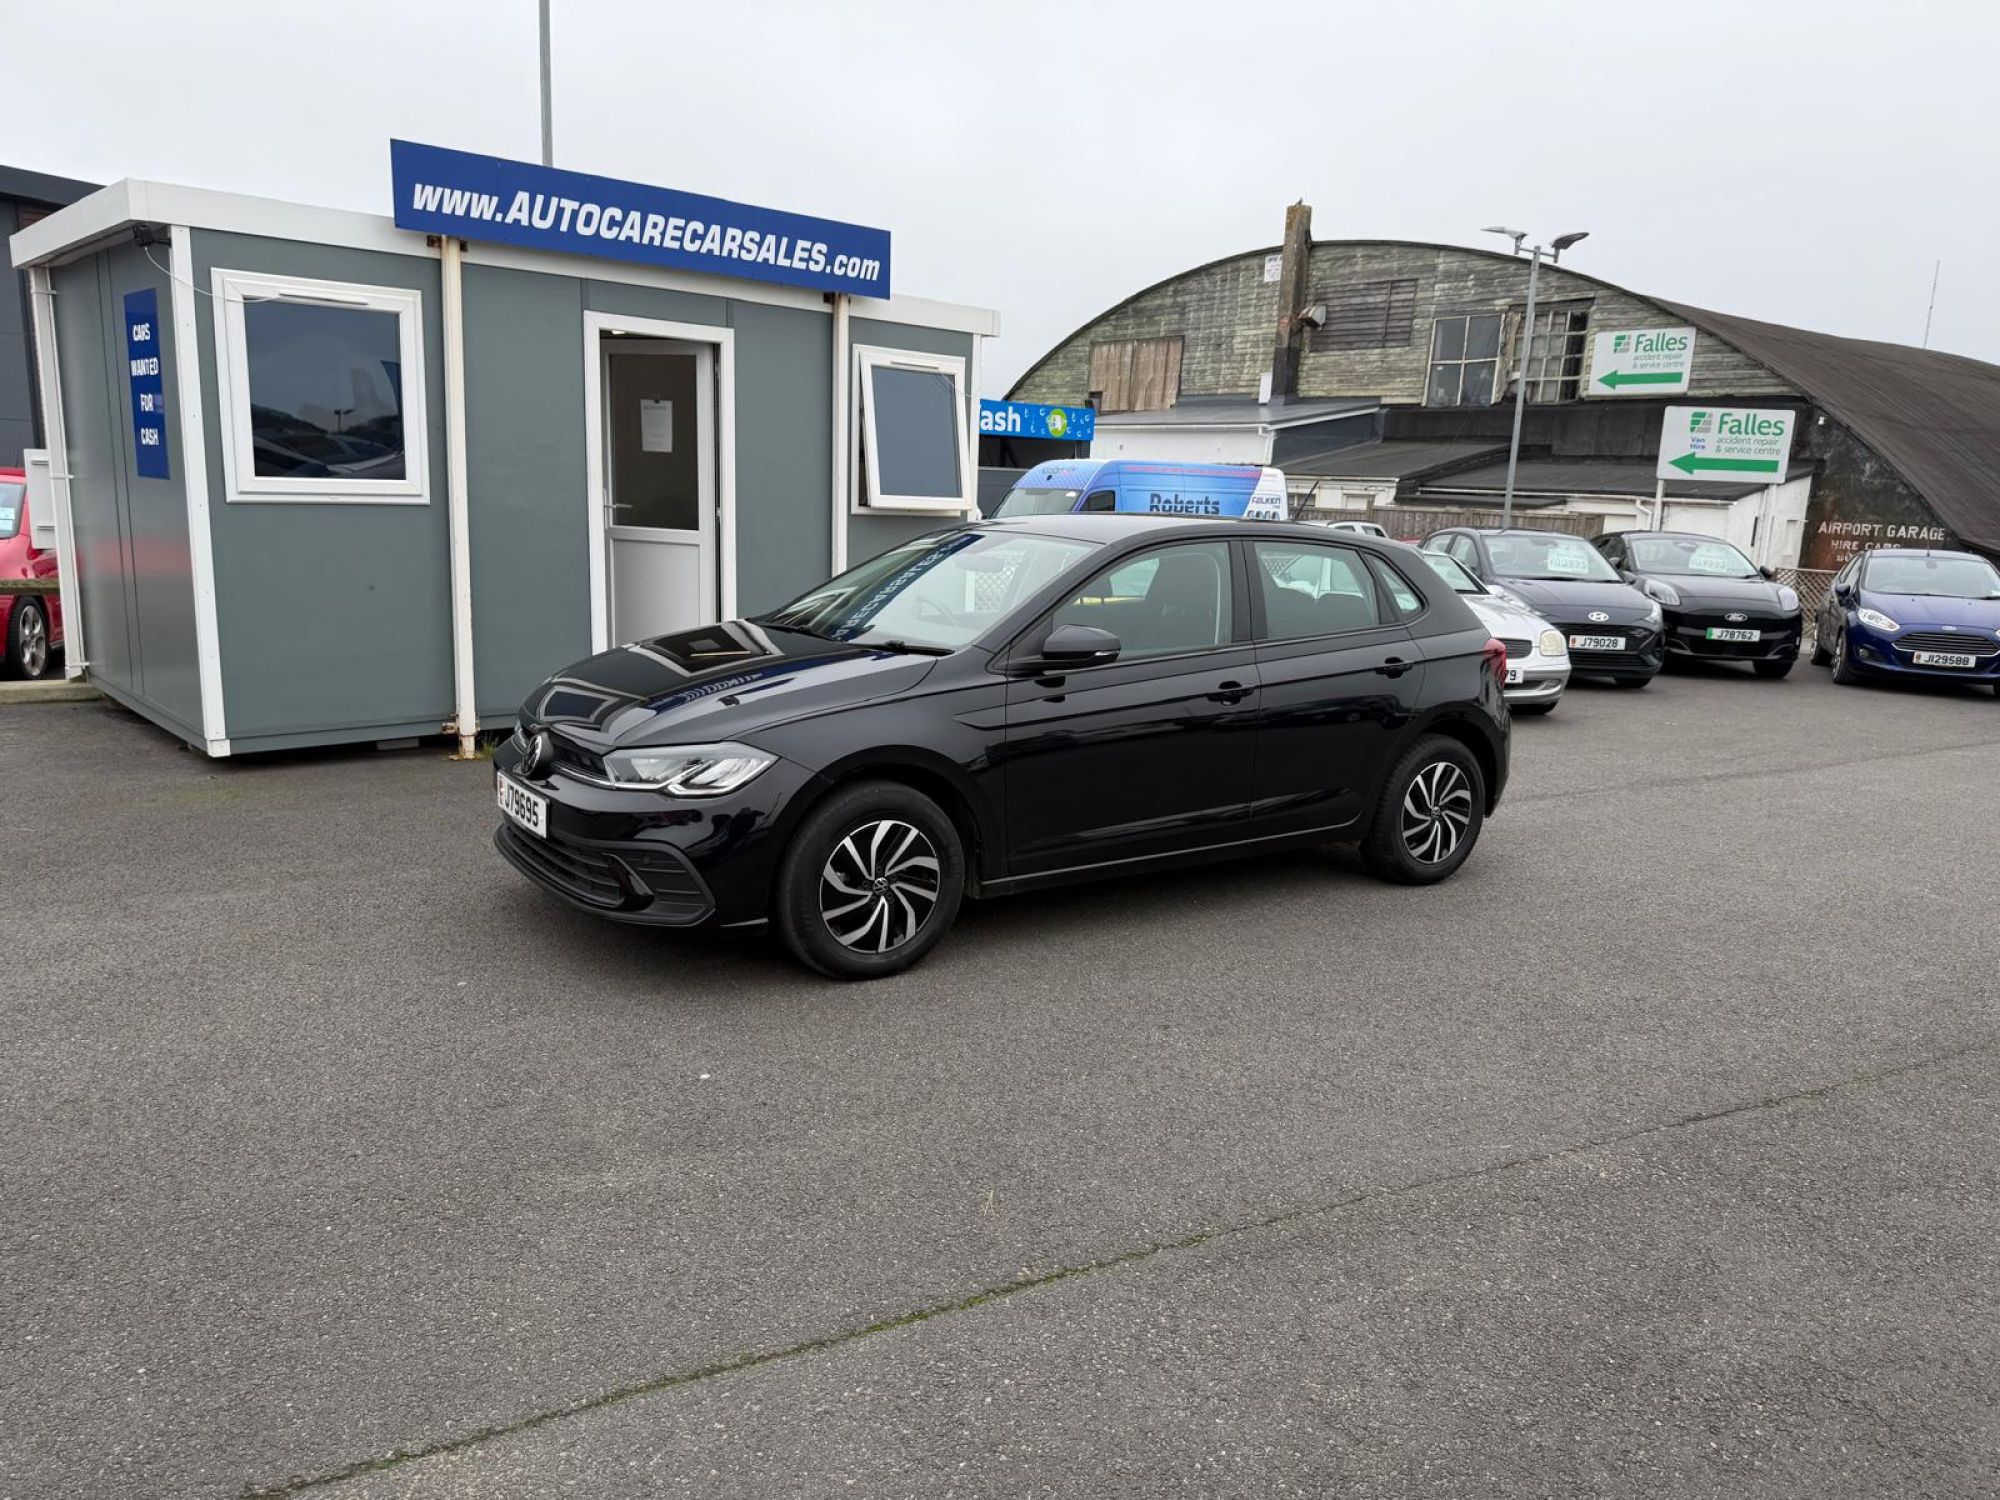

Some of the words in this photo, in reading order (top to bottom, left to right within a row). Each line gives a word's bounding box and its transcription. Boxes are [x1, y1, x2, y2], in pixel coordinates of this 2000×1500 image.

[1635, 332, 1688, 352] Falles
[130, 357, 160, 376] WANTED
[140, 394, 154, 412] FOR
[979, 406, 1021, 433] ash
[1718, 413, 1785, 436] Falles
[141, 428, 160, 445] CASH
[1716, 437, 1751, 445] accident
[1753, 439, 1779, 447] repair
[1724, 446, 1752, 454] service
[1753, 447, 1781, 456] centre
[1150, 493, 1220, 515] Roberts
[1818, 521, 1883, 536] AIRPORT
[1886, 524, 1946, 541] GARAGE
[1831, 540, 1860, 550] HIRE
[1580, 636, 1618, 648] J79028
[504, 783, 539, 828] J79695
